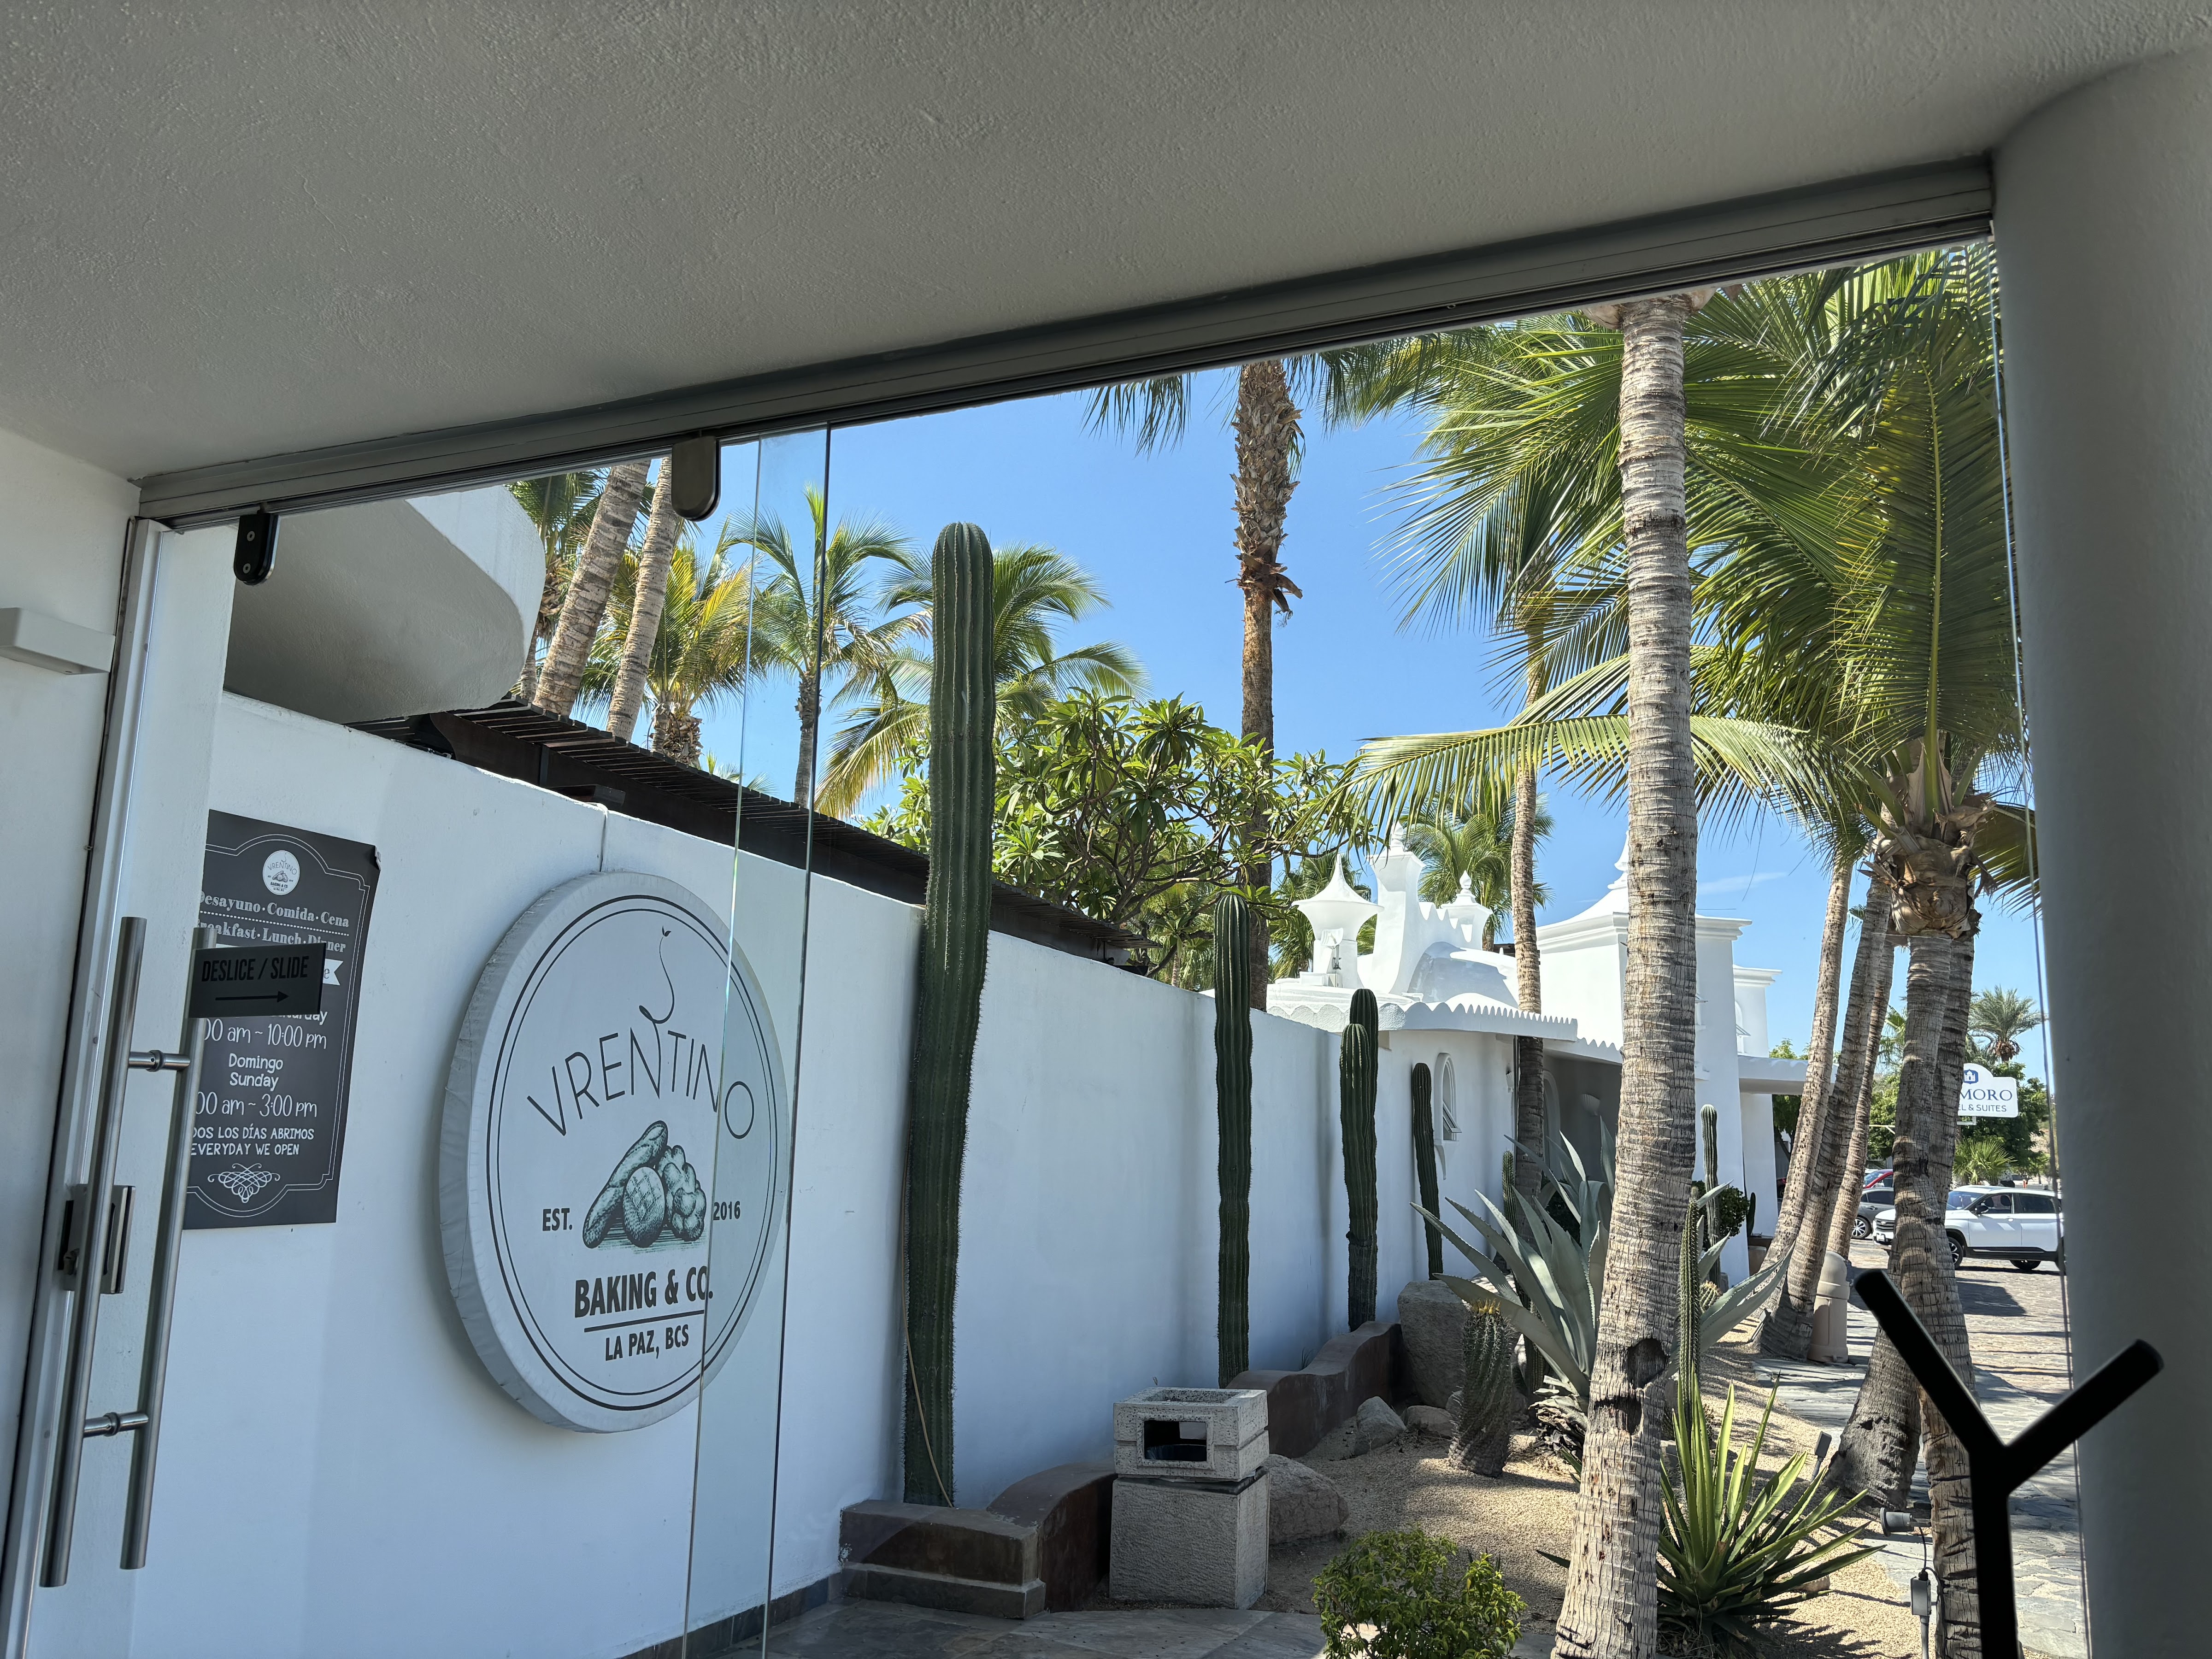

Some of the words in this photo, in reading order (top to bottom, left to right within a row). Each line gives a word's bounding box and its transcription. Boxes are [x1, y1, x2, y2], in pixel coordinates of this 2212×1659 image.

[268, 861, 297, 875] VRENTINO
[267, 902, 315, 922] Comida
[320, 912, 349, 927] Cena
[262, 928, 302, 945] Lunch
[308, 935, 346, 953] Diner
[201, 959, 256, 982] DESLICE
[271, 956, 309, 979] SLIDE
[227, 1027, 251, 1043] am
[268, 1024, 303, 1047] 10:00
[306, 1033, 327, 1049] pm
[229, 1053, 283, 1074] Domingo
[527, 1004, 754, 1139] VRENTINO
[229, 1072, 279, 1091] Sunday
[222, 1099, 244, 1115] am
[259, 1094, 293, 1117] 3:00
[295, 1102, 317, 1118] pm
[218, 1127, 239, 1139] LOS
[242, 1123, 267, 1139] DÍAS
[270, 1128, 314, 1140] ABRIMOS
[191, 1143, 251, 1155] EVERYDAY
[255, 1143, 271, 1155] WE
[274, 1144, 300, 1155] OPEN
[542, 1207, 573, 1231] EST.
[713, 1201, 741, 1221] 2016
[575, 1271, 657, 1318] BAKING
[665, 1269, 679, 1305] &
[686, 1265, 713, 1302] CO.
[605, 1335, 623, 1361] LA
[629, 1330, 659, 1359] PAZ,
[665, 1324, 689, 1349] BCS
